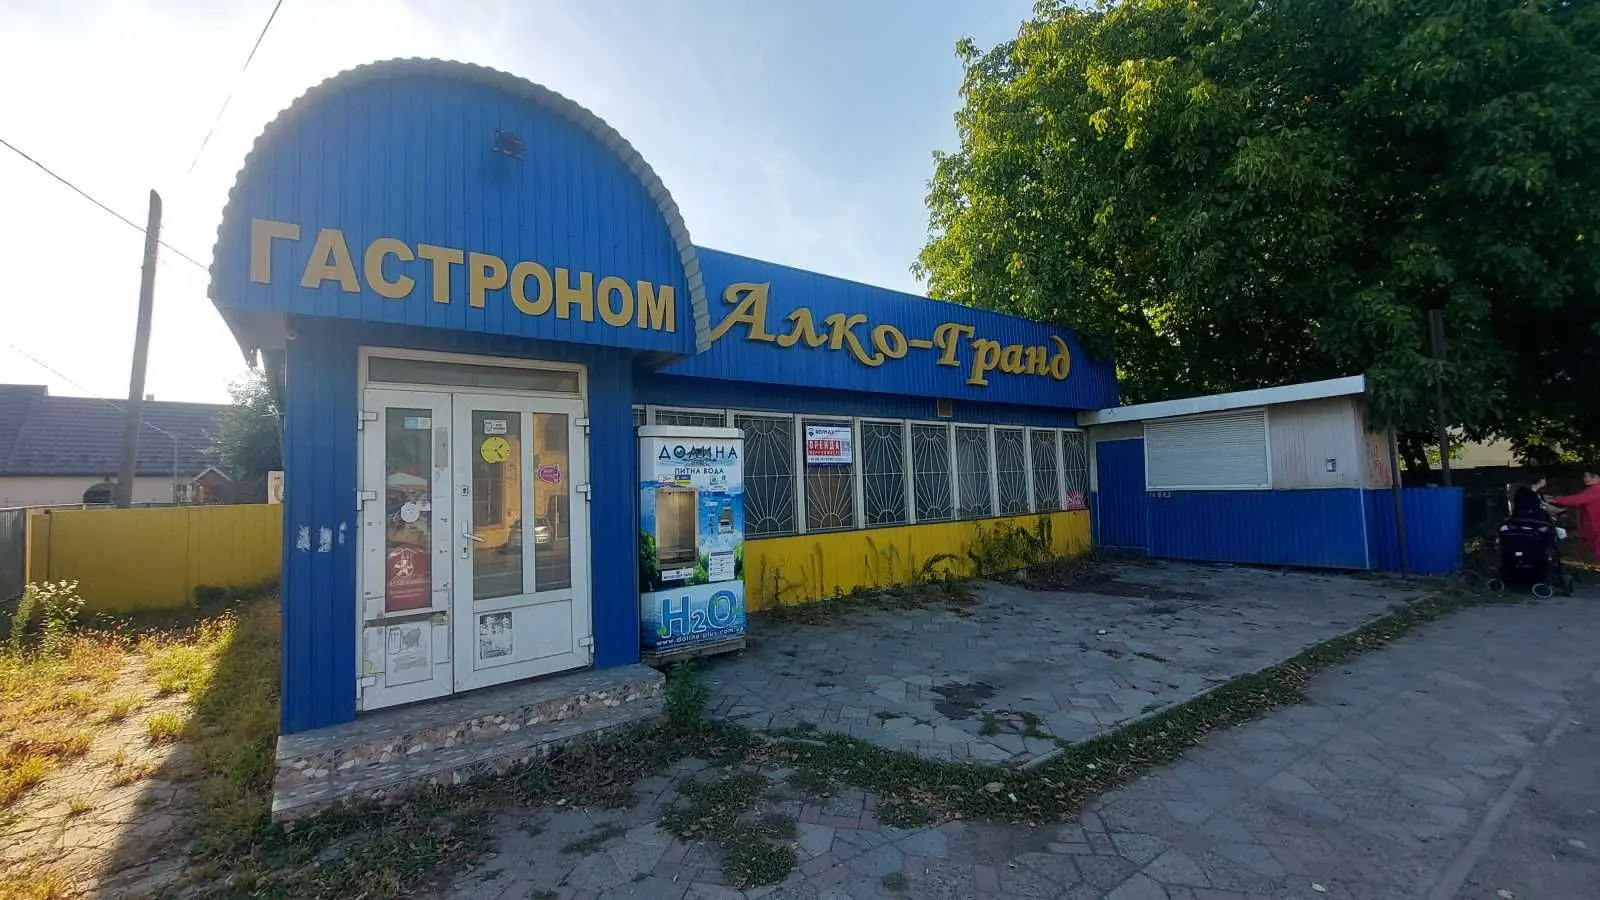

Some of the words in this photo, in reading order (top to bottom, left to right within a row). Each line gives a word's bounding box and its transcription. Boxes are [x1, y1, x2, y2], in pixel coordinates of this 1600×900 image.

[250, 218, 676, 333] ГАСТРОНОМ
[658, 444, 738, 460] ДОЛИНА
[809, 440, 840, 450] ОРЕНДА
[674, 467, 701, 475] ПИТНА
[703, 467, 725, 475] ВОДА
[661, 590, 738, 638] H2O
